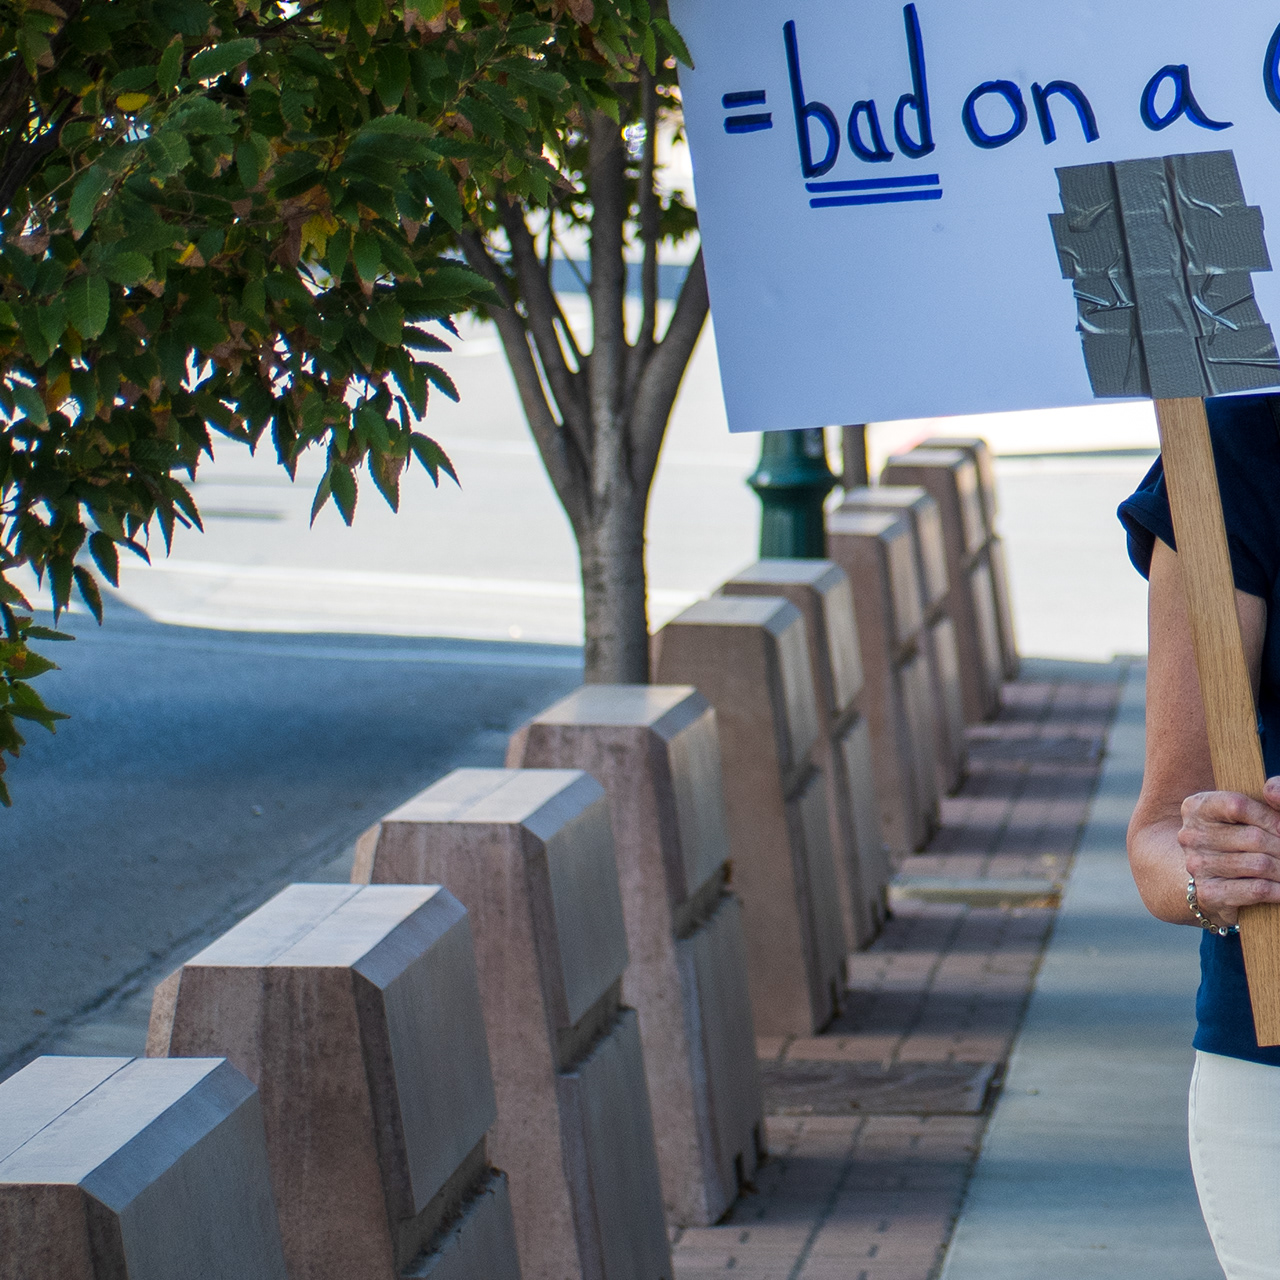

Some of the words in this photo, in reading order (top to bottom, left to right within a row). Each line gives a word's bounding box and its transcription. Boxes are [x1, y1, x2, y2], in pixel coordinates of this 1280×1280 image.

[783, 1, 937, 180] bad
[961, 78, 1101, 150] on
[1139, 63, 1235, 132] a
